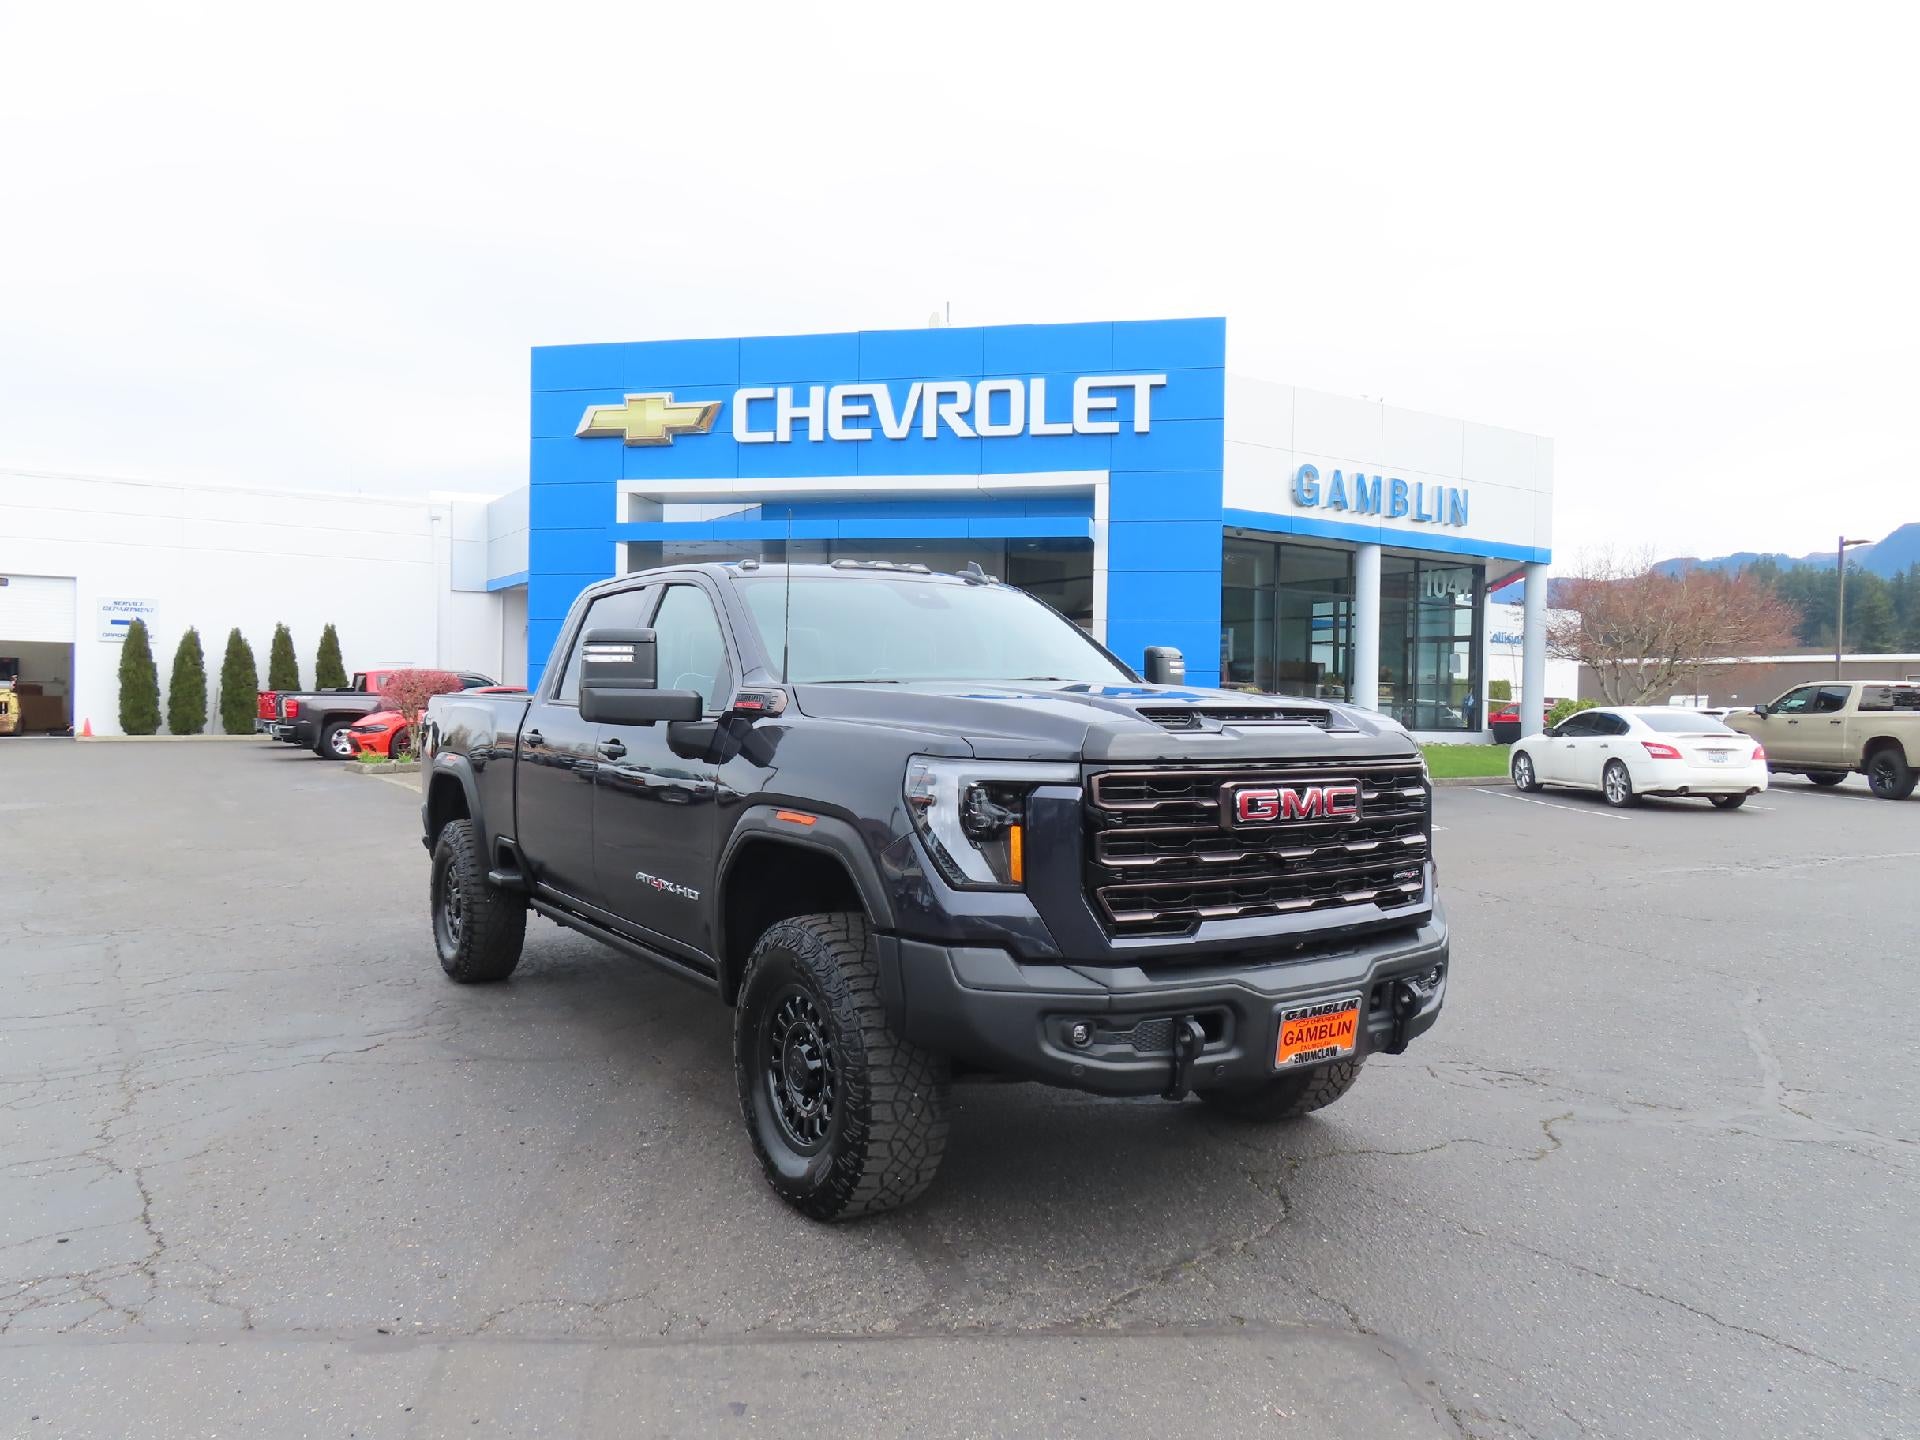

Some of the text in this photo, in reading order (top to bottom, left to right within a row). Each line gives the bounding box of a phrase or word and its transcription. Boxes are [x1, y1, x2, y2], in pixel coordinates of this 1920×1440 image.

[733, 375, 1167, 443] CHEVROLET
[1292, 463, 1468, 527] GAMBLIN
[1236, 786, 1360, 822] GMC
[1285, 998, 1359, 1021] GAMBLIN
[1283, 1020, 1353, 1047] GAMBLIN
[1294, 1045, 1338, 1064] ENUMCLAW
